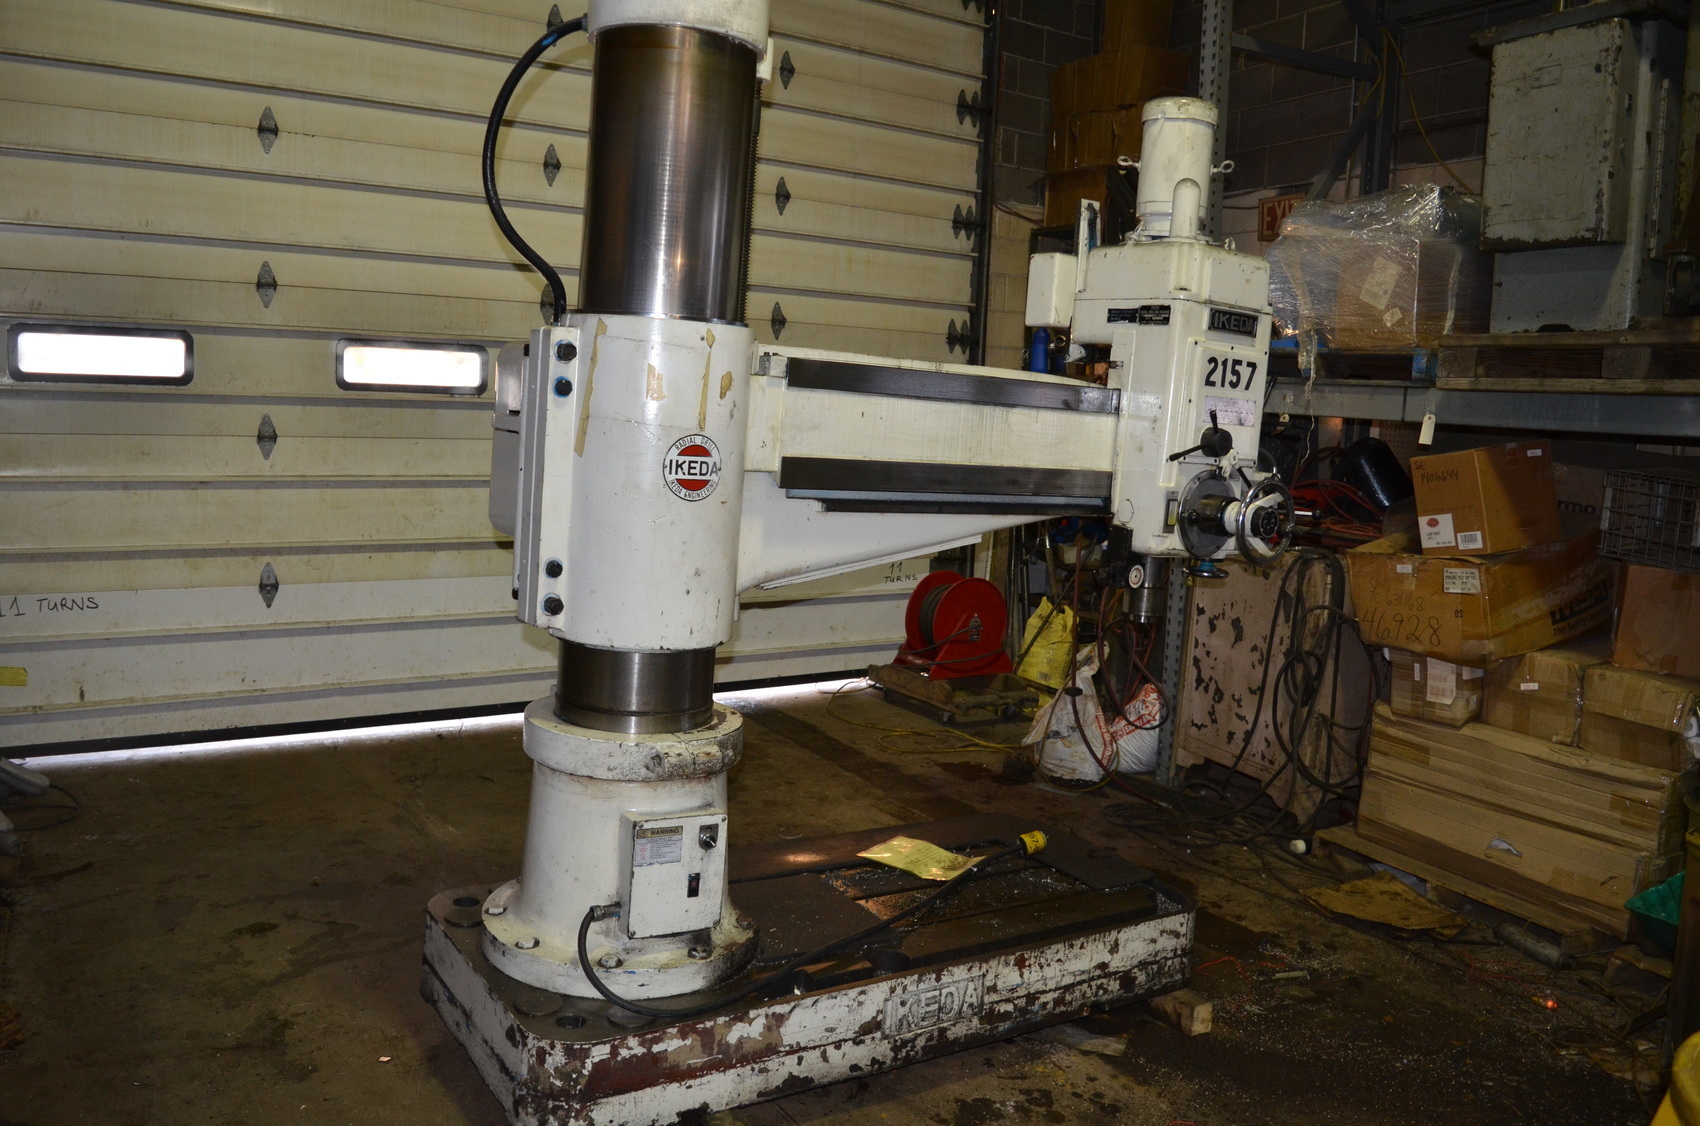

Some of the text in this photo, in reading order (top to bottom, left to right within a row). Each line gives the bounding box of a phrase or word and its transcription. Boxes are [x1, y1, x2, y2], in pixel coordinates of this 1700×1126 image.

[1204, 356, 1257, 391] 2157
[674, 437, 697, 451] RADIAL
[668, 459, 719, 477] IKEDA
[669, 479, 717, 500] IKEDA ENGINEERING
[889, 561, 903, 575] 11
[884, 574, 918, 584] TURNS
[36, 597, 99, 612] TURNS
[1361, 608, 1442, 647] 46928
[650, 828, 679, 836] WARNING
[884, 979, 980, 1034] IKEDA
